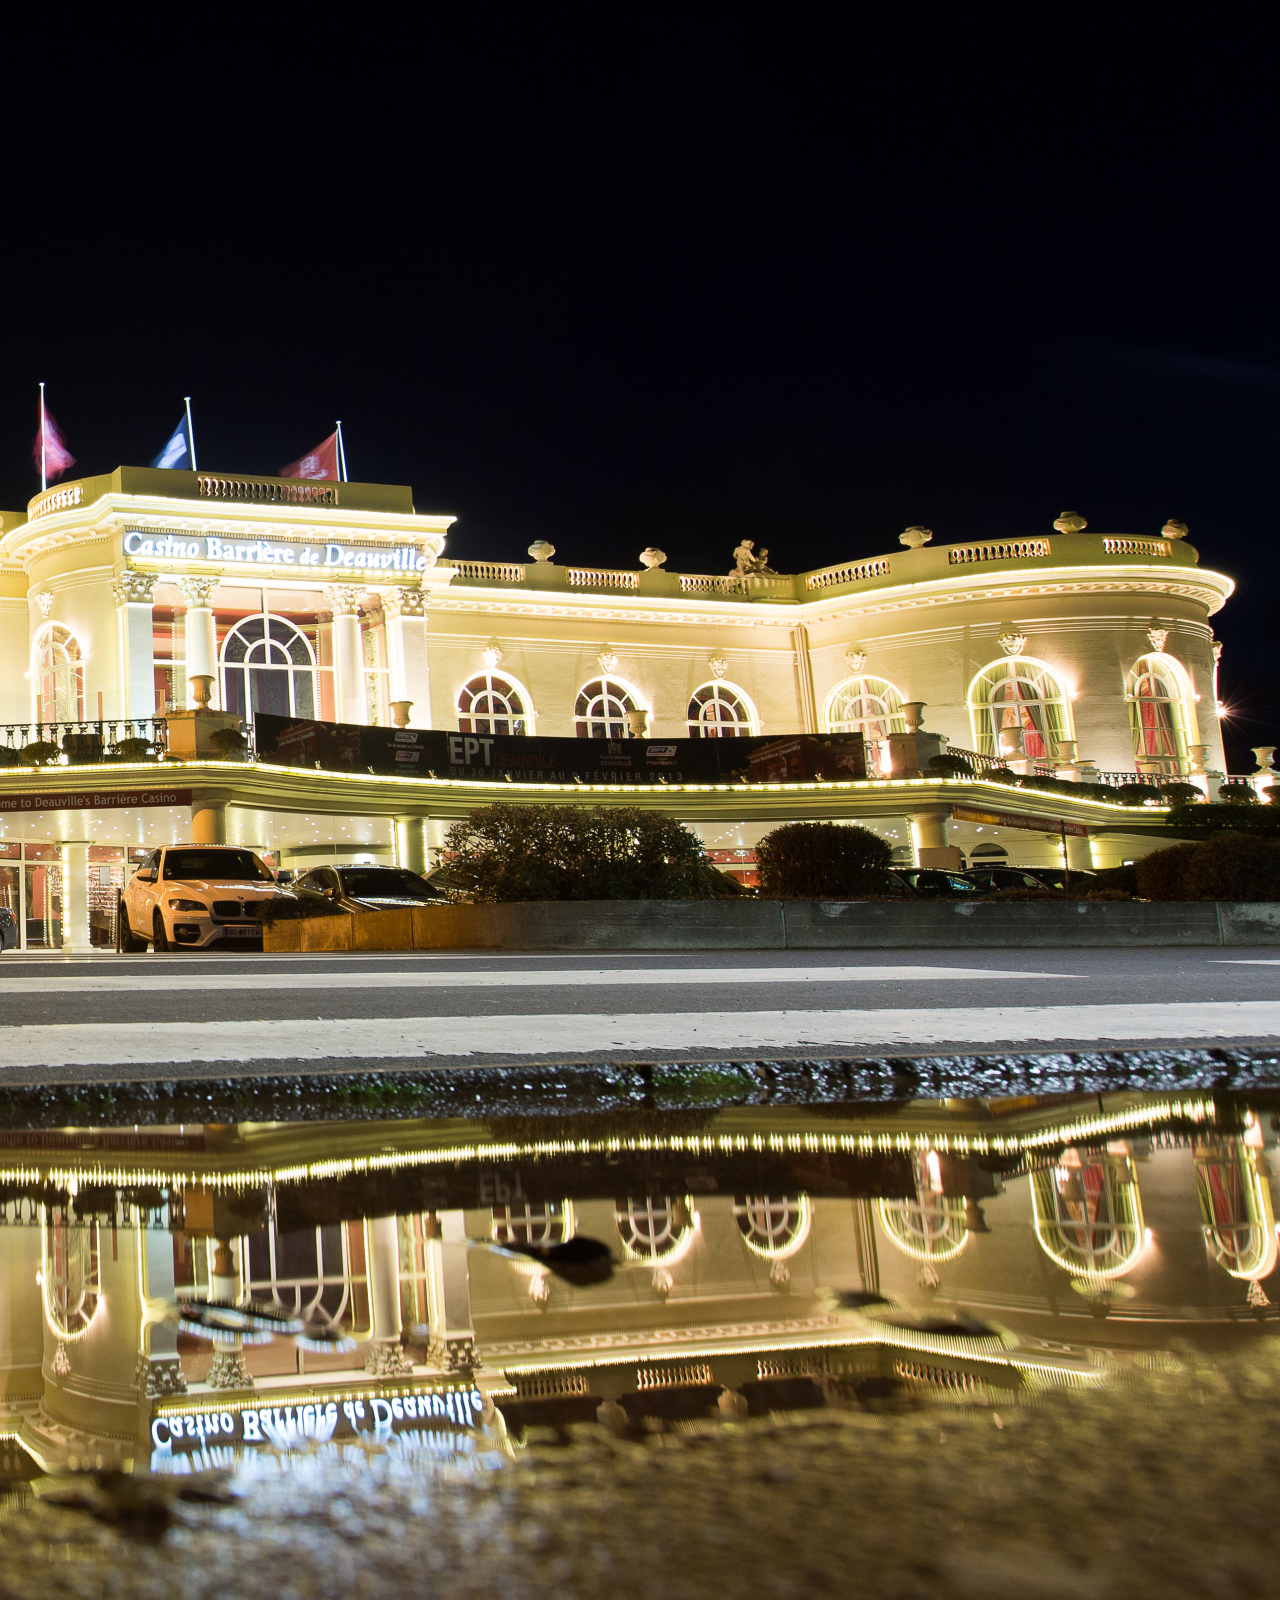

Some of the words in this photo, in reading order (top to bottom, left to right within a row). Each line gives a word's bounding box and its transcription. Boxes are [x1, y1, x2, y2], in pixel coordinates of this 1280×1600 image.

[124, 531, 200, 559] Casino
[206, 537, 295, 565] Barrière
[299, 546, 320, 565] de
[324, 544, 428, 571] Deauville
[449, 736, 495, 766] EPT
[494, 753, 557, 769] DEAUVILLE
[450, 766, 465, 776] DU
[471, 768, 484, 777] 30
[491, 769, 544, 780] JANVIER
[550, 771, 565, 780] AU
[585, 770, 641, 781] FÉVRIER
[649, 772, 683, 781] 2013
[20, 798, 32, 808] to
[35, 796, 91, 807] Deauville's
[94, 793, 138, 805] Barrière
[141, 792, 177, 803] Casino
